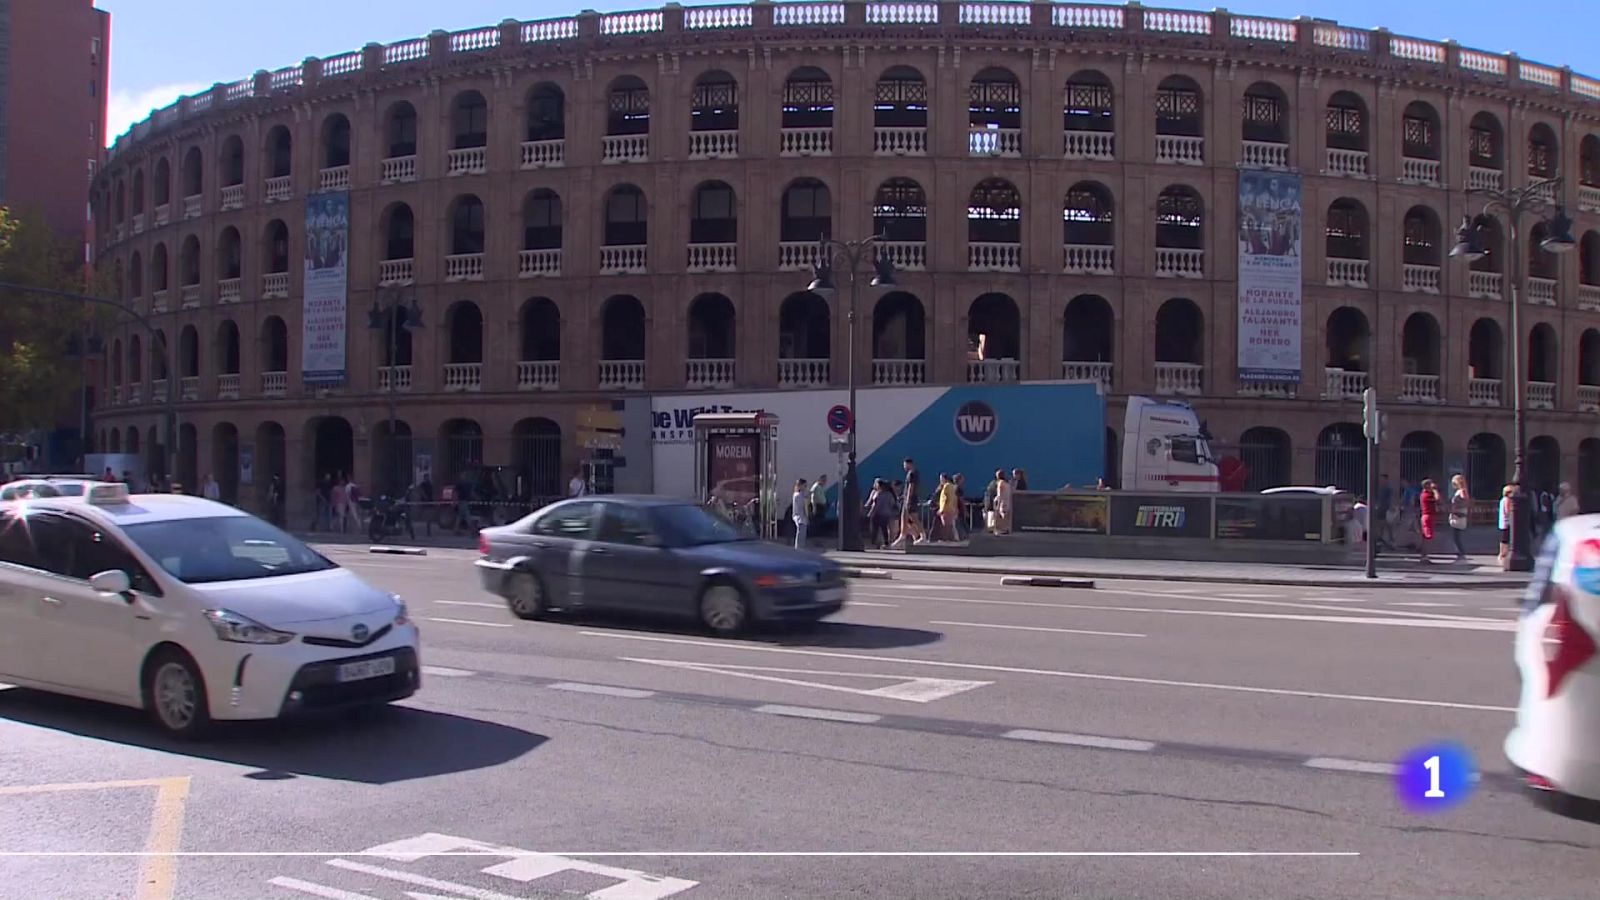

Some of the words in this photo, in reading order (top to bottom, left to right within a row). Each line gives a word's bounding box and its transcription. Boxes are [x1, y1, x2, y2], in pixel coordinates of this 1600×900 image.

[1246, 289, 1294, 298] MORANTE
[1244, 308, 1296, 317] ALEJANDRO
[1242, 316, 1299, 326] TALAVANTE
[1249, 337, 1291, 346] ROMERO
[958, 415, 994, 433] TWT
[715, 445, 752, 459] MORENA
[1154, 511, 1180, 527] TRI
